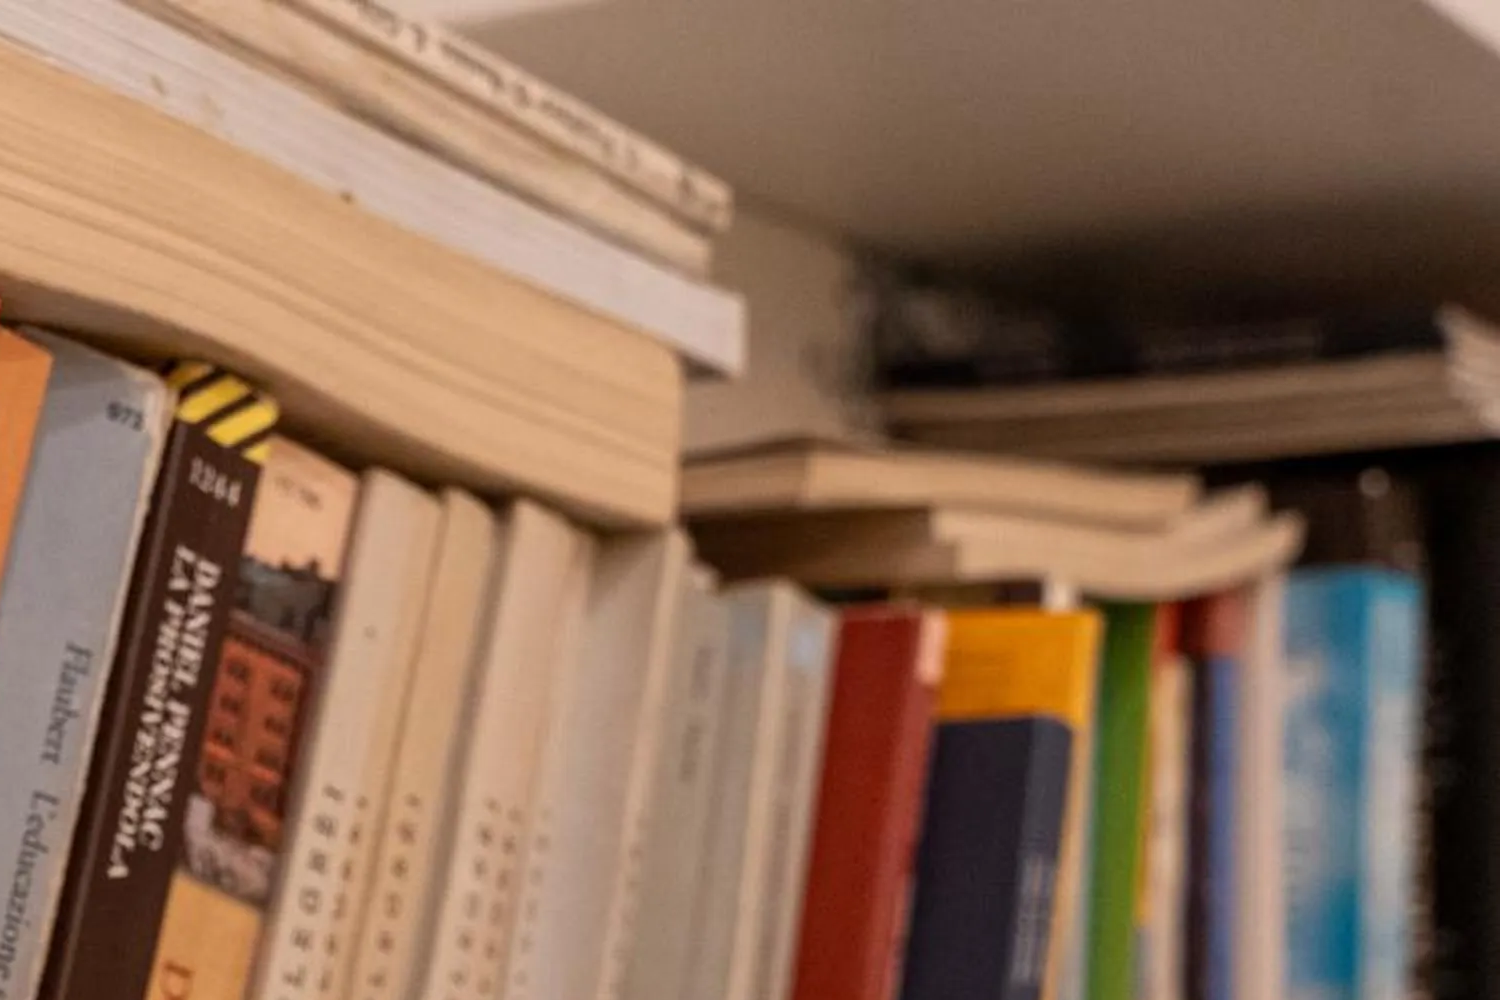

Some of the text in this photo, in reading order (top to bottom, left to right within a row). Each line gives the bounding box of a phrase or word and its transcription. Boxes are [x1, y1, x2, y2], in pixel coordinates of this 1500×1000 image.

[169, 544, 197, 589] LA
[41, 642, 92, 766] Flaubert
[136, 558, 221, 851] DANIEL PENNAC
